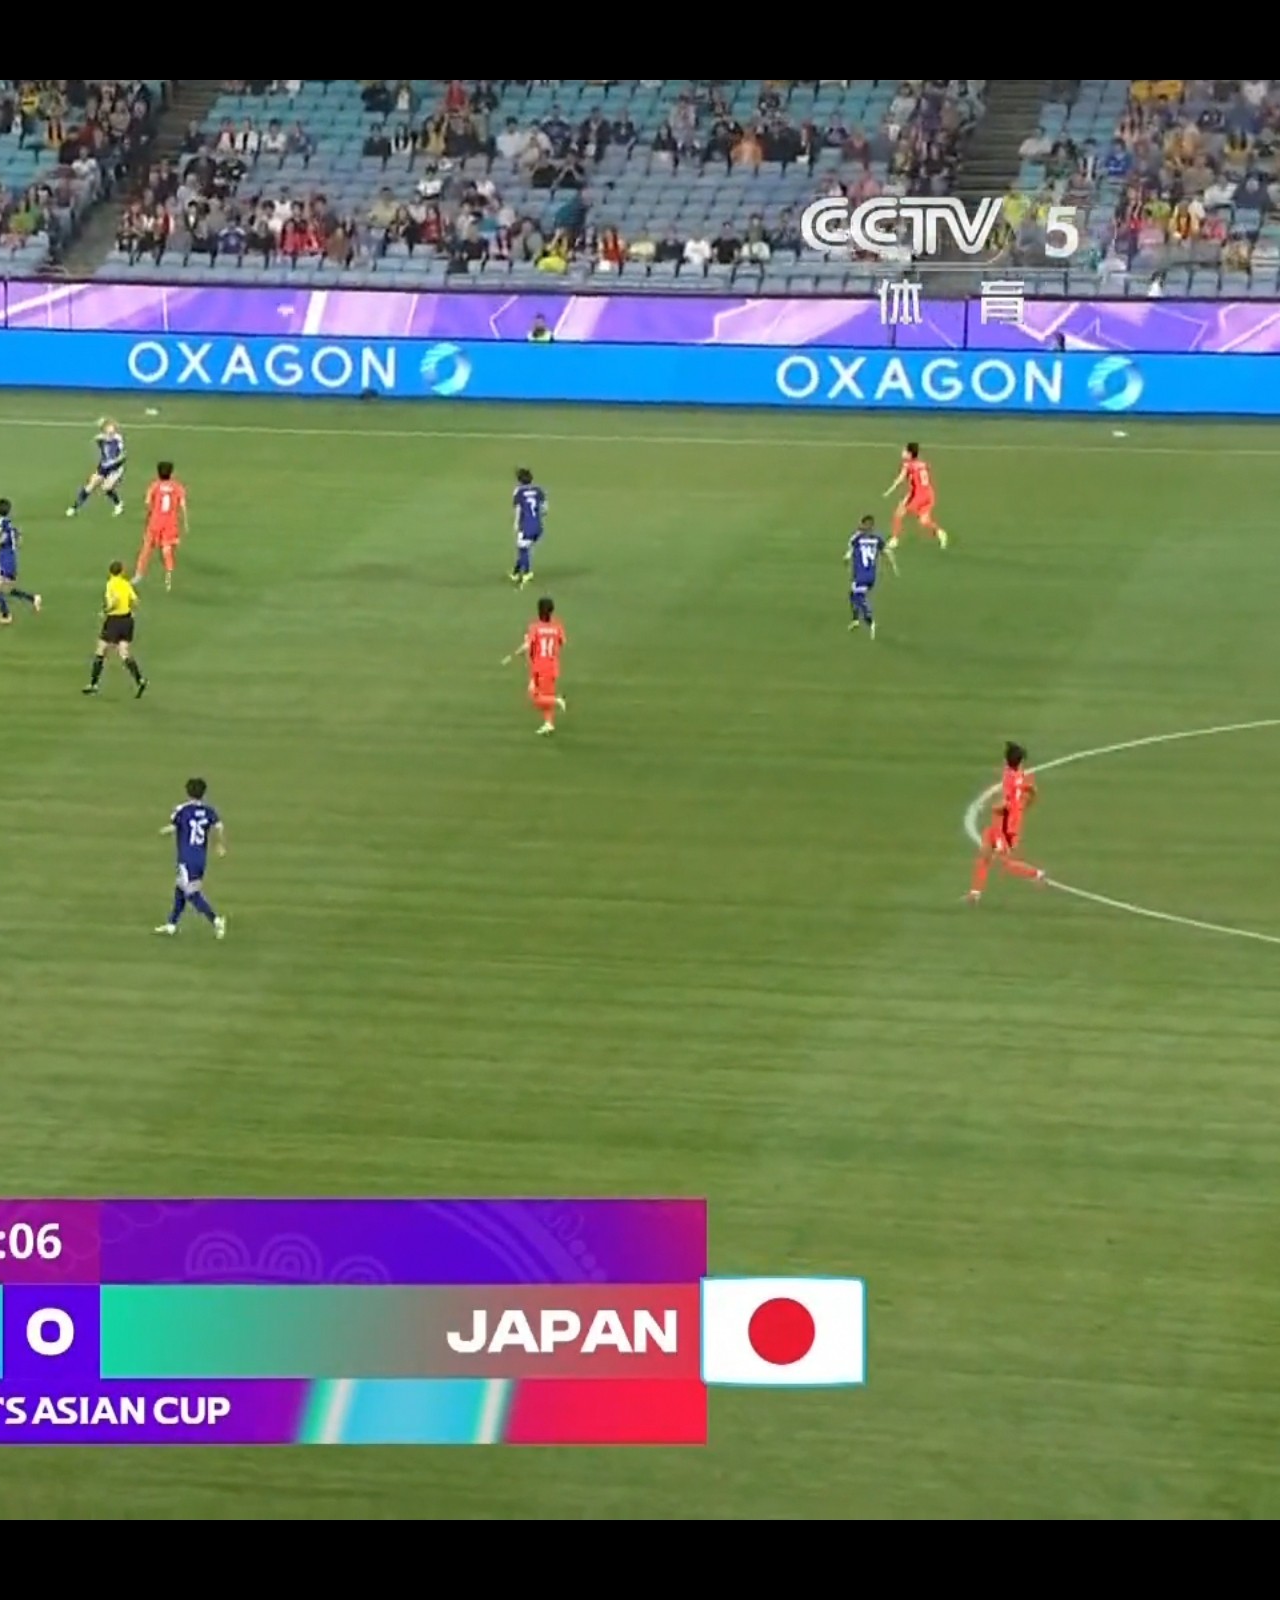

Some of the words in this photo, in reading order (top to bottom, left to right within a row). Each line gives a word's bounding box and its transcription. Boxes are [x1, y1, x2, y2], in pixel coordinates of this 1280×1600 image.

[129, 341, 396, 389] OXAGON
[777, 355, 1063, 403] OXAGON
[859, 545, 877, 567] 14
[189, 818, 209, 845] 15
